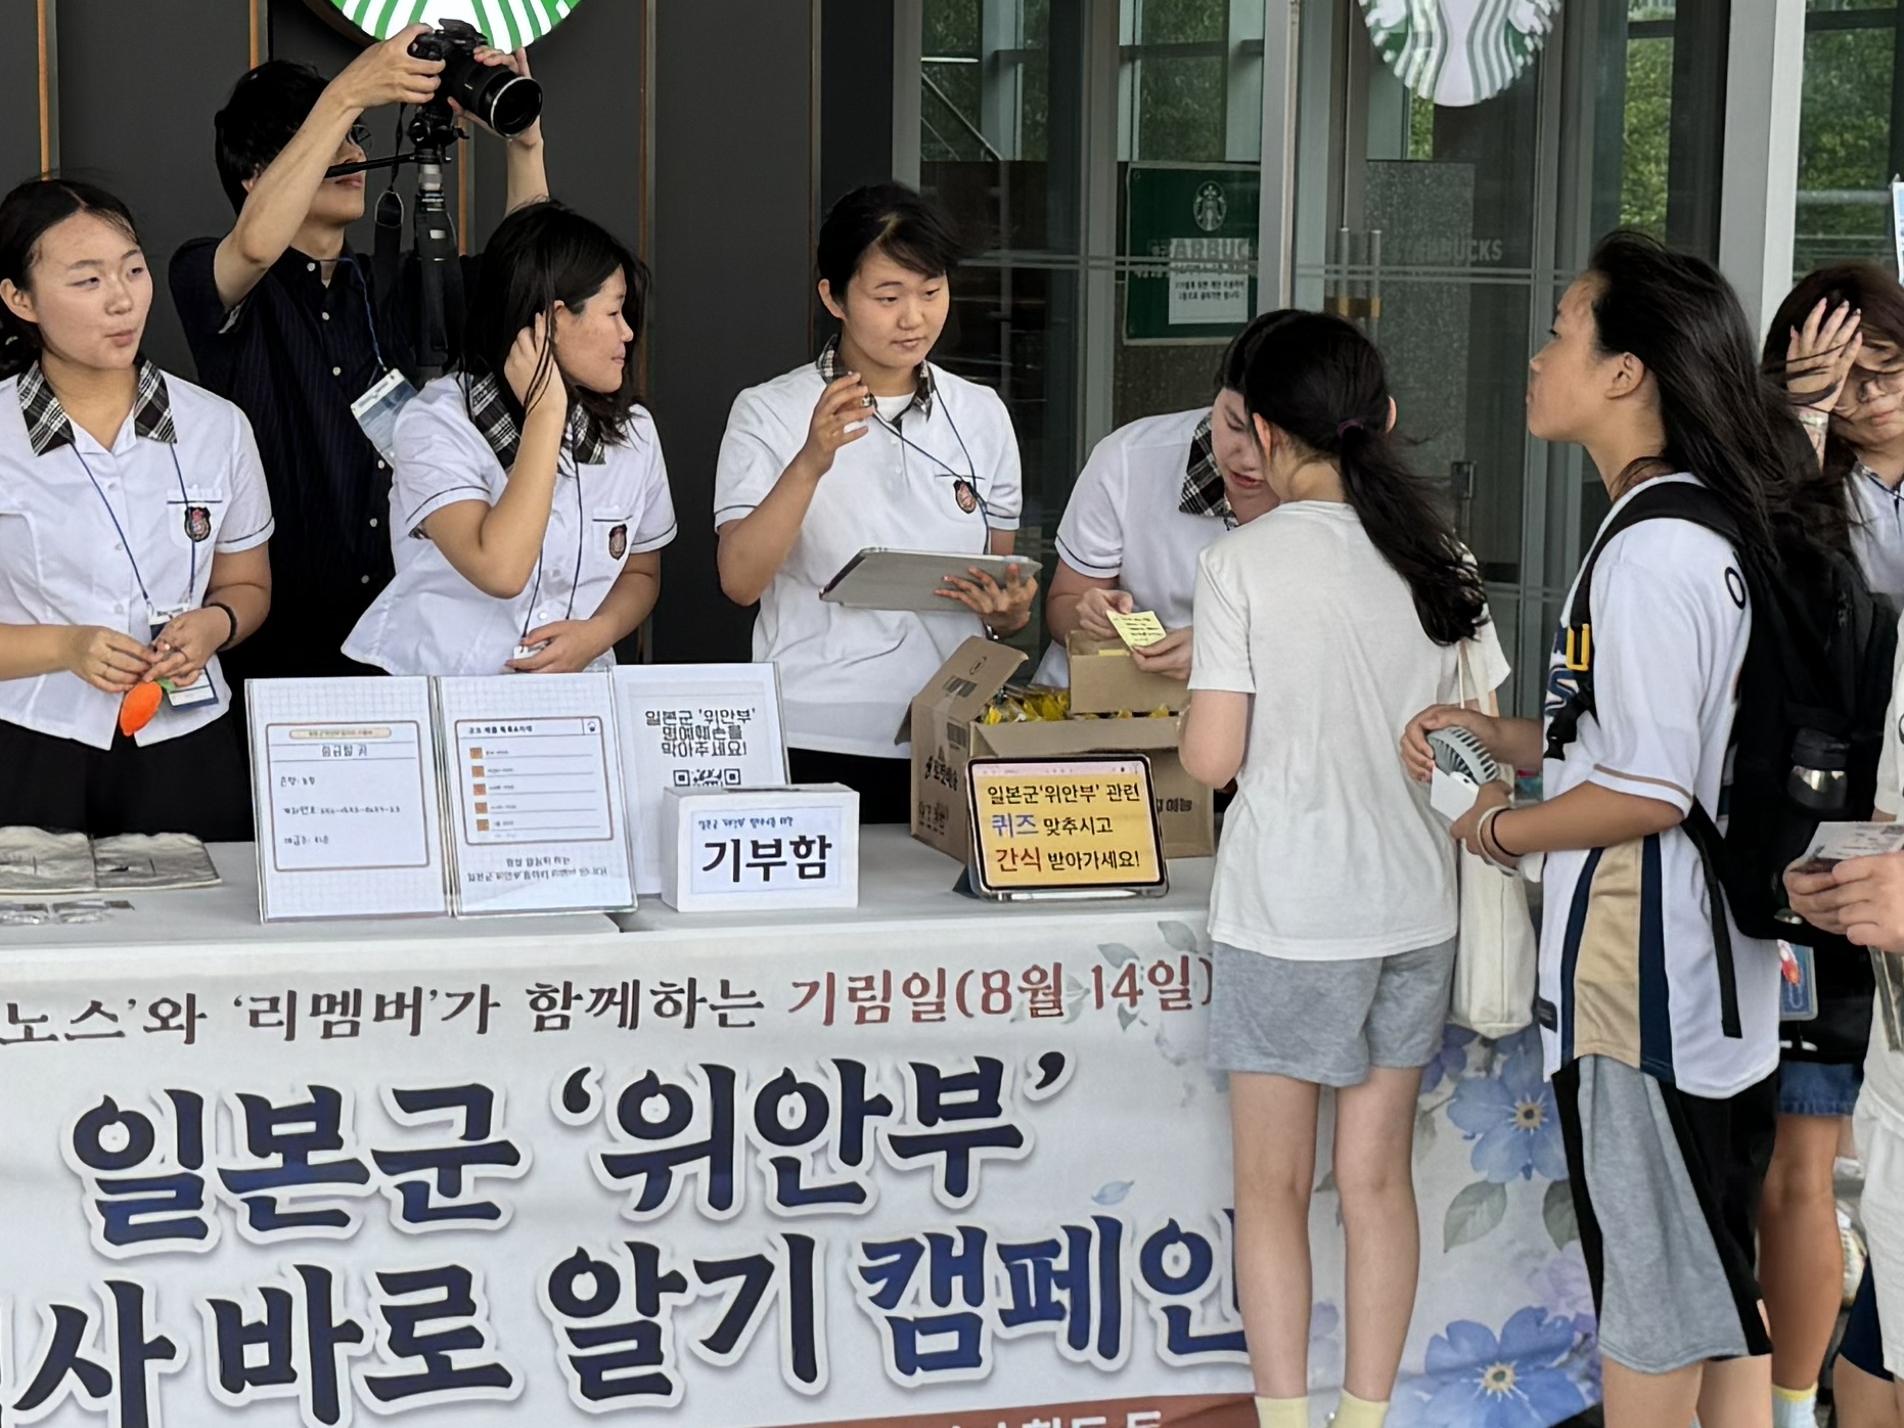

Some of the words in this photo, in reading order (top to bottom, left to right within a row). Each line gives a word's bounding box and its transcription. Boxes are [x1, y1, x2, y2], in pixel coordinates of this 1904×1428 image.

[1106, 782, 1140, 802] 관련
[992, 813, 1039, 838] 퀴즈
[1043, 816, 1114, 837] 맞추시고
[702, 835, 832, 883] 기부함
[996, 846, 1042, 872] 간식
[1047, 850, 1140, 871] 받아가세요!
[525, 977, 765, 1033] 함께하는
[790, 963, 1066, 1027] 기림일(8월
[1090, 954, 1213, 1011] 14일)
[73, 1083, 520, 1246] 일본군
[205, 1264, 513, 1425] 바로
[548, 1233, 818, 1402] 알기
[858, 1208, 1250, 1377] 캠페인
